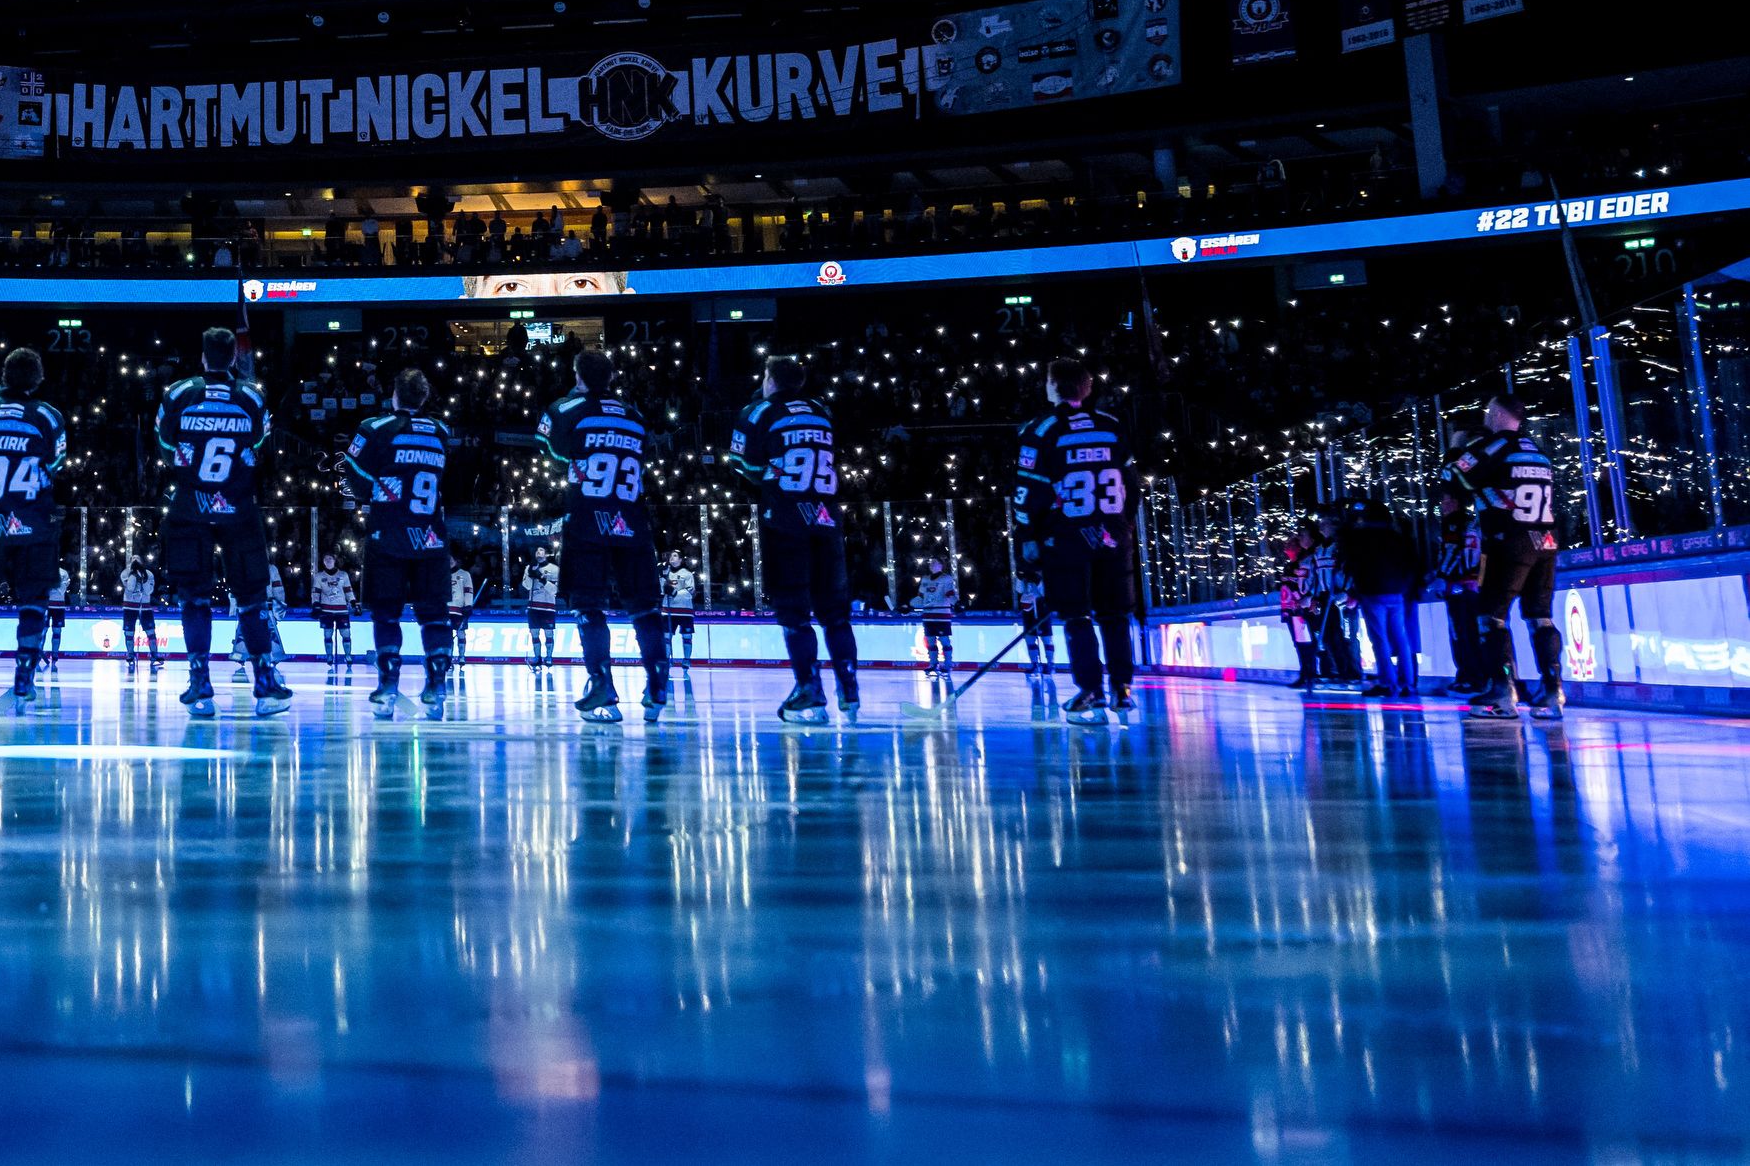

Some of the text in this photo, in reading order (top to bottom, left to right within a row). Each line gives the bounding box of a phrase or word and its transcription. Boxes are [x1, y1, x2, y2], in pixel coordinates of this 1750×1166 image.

[72, 37, 905, 150] HARTMUT NICKEL KURVE
[578, 68, 680, 127] HNK
[1476, 191, 1670, 232] #22 TOBI EDER
[1199, 234, 1260, 249] EISBÄREN
[267, 280, 317, 292] EISBÄREN
[47, 328, 92, 353] 213
[180, 415, 253, 433] WISSMANN
[584, 430, 643, 454] PFÖDERL
[780, 429, 834, 446] TIFFELS
[198, 437, 237, 483] 6
[581, 452, 641, 503] 93
[778, 447, 838, 495] 95
[409, 470, 438, 515] 9
[1061, 468, 1126, 518] 33
